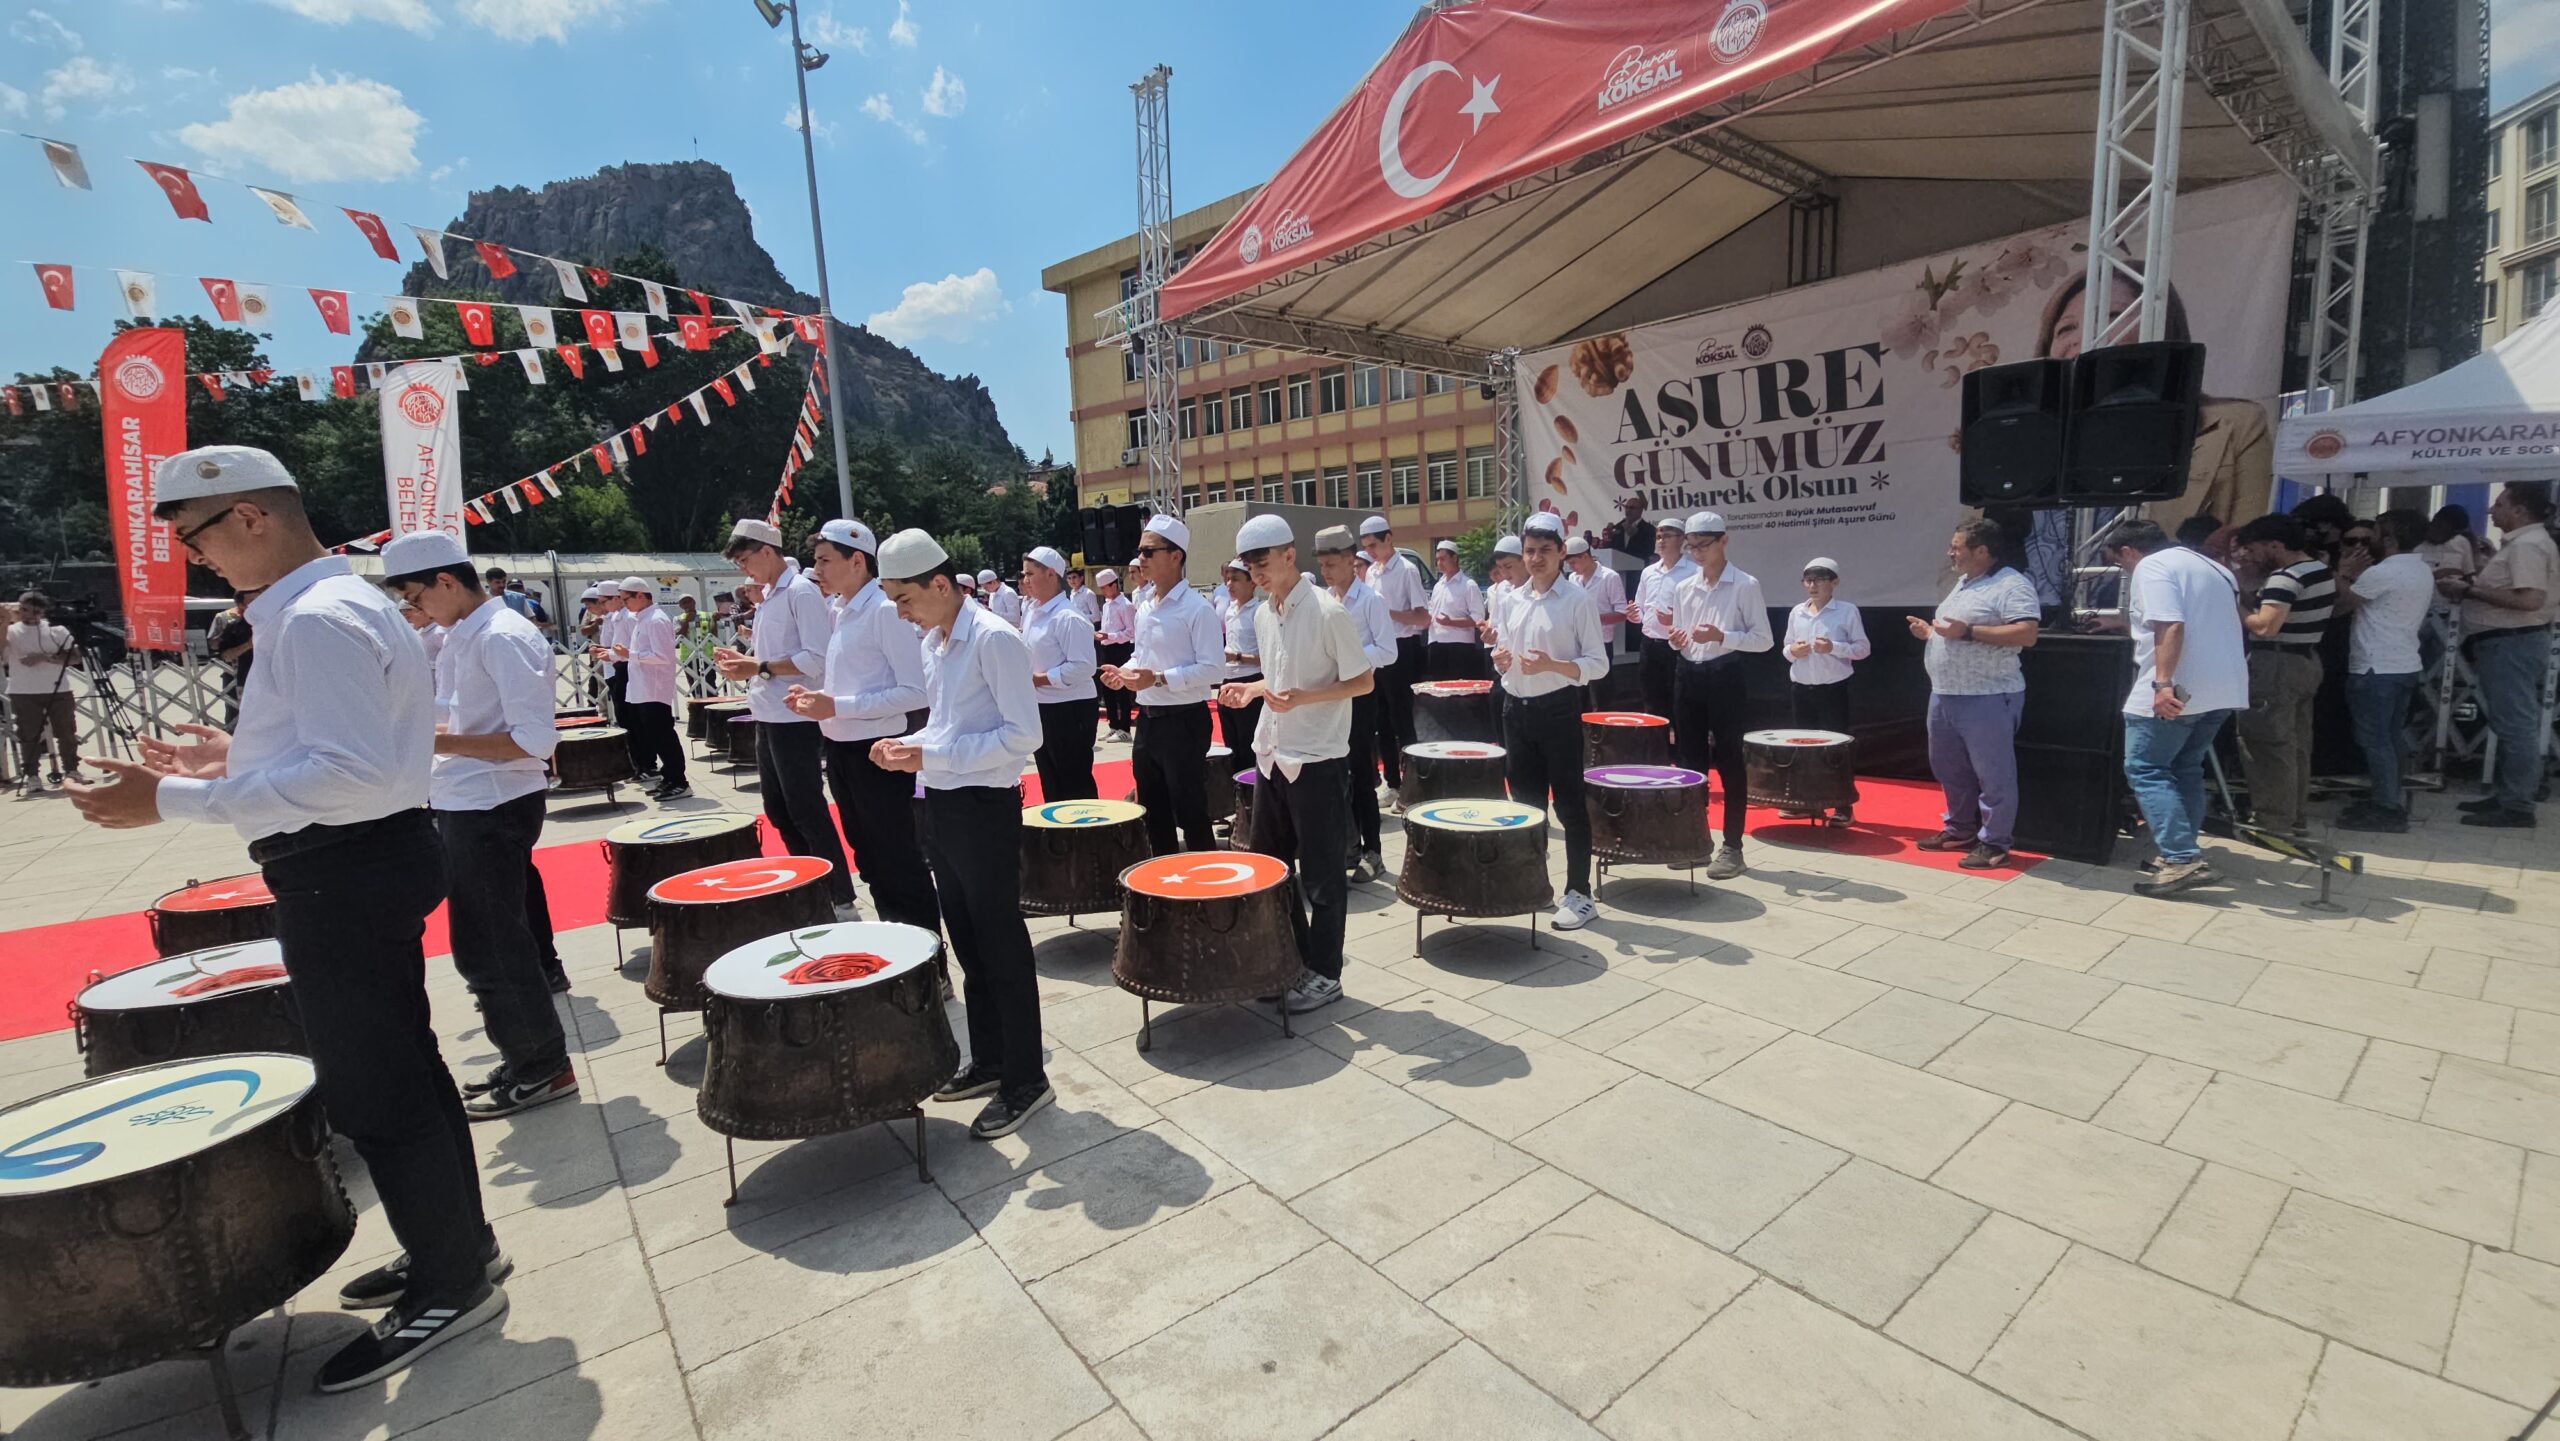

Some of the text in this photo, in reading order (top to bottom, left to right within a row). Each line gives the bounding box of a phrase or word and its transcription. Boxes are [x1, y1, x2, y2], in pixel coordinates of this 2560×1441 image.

[1598, 60, 1682, 109] KÖKSAL
[1270, 223, 1314, 252] KÖKSAL
[1695, 349, 1738, 365] KÖKSAL
[1613, 416, 1885, 489] GÜNÜMÜZ
[2412, 446, 2482, 459] KÜLTÜR
[2488, 446, 2511, 456] VE
[1763, 474, 1857, 501] Olsun
[121, 417, 149, 593] AFYONKARAHİSAR
[1785, 508, 1814, 518] Büyük
[1816, 502, 1877, 514] Mutasavvuf
[1838, 515, 1865, 526] Aşure
[1868, 512, 1896, 522] Günü
